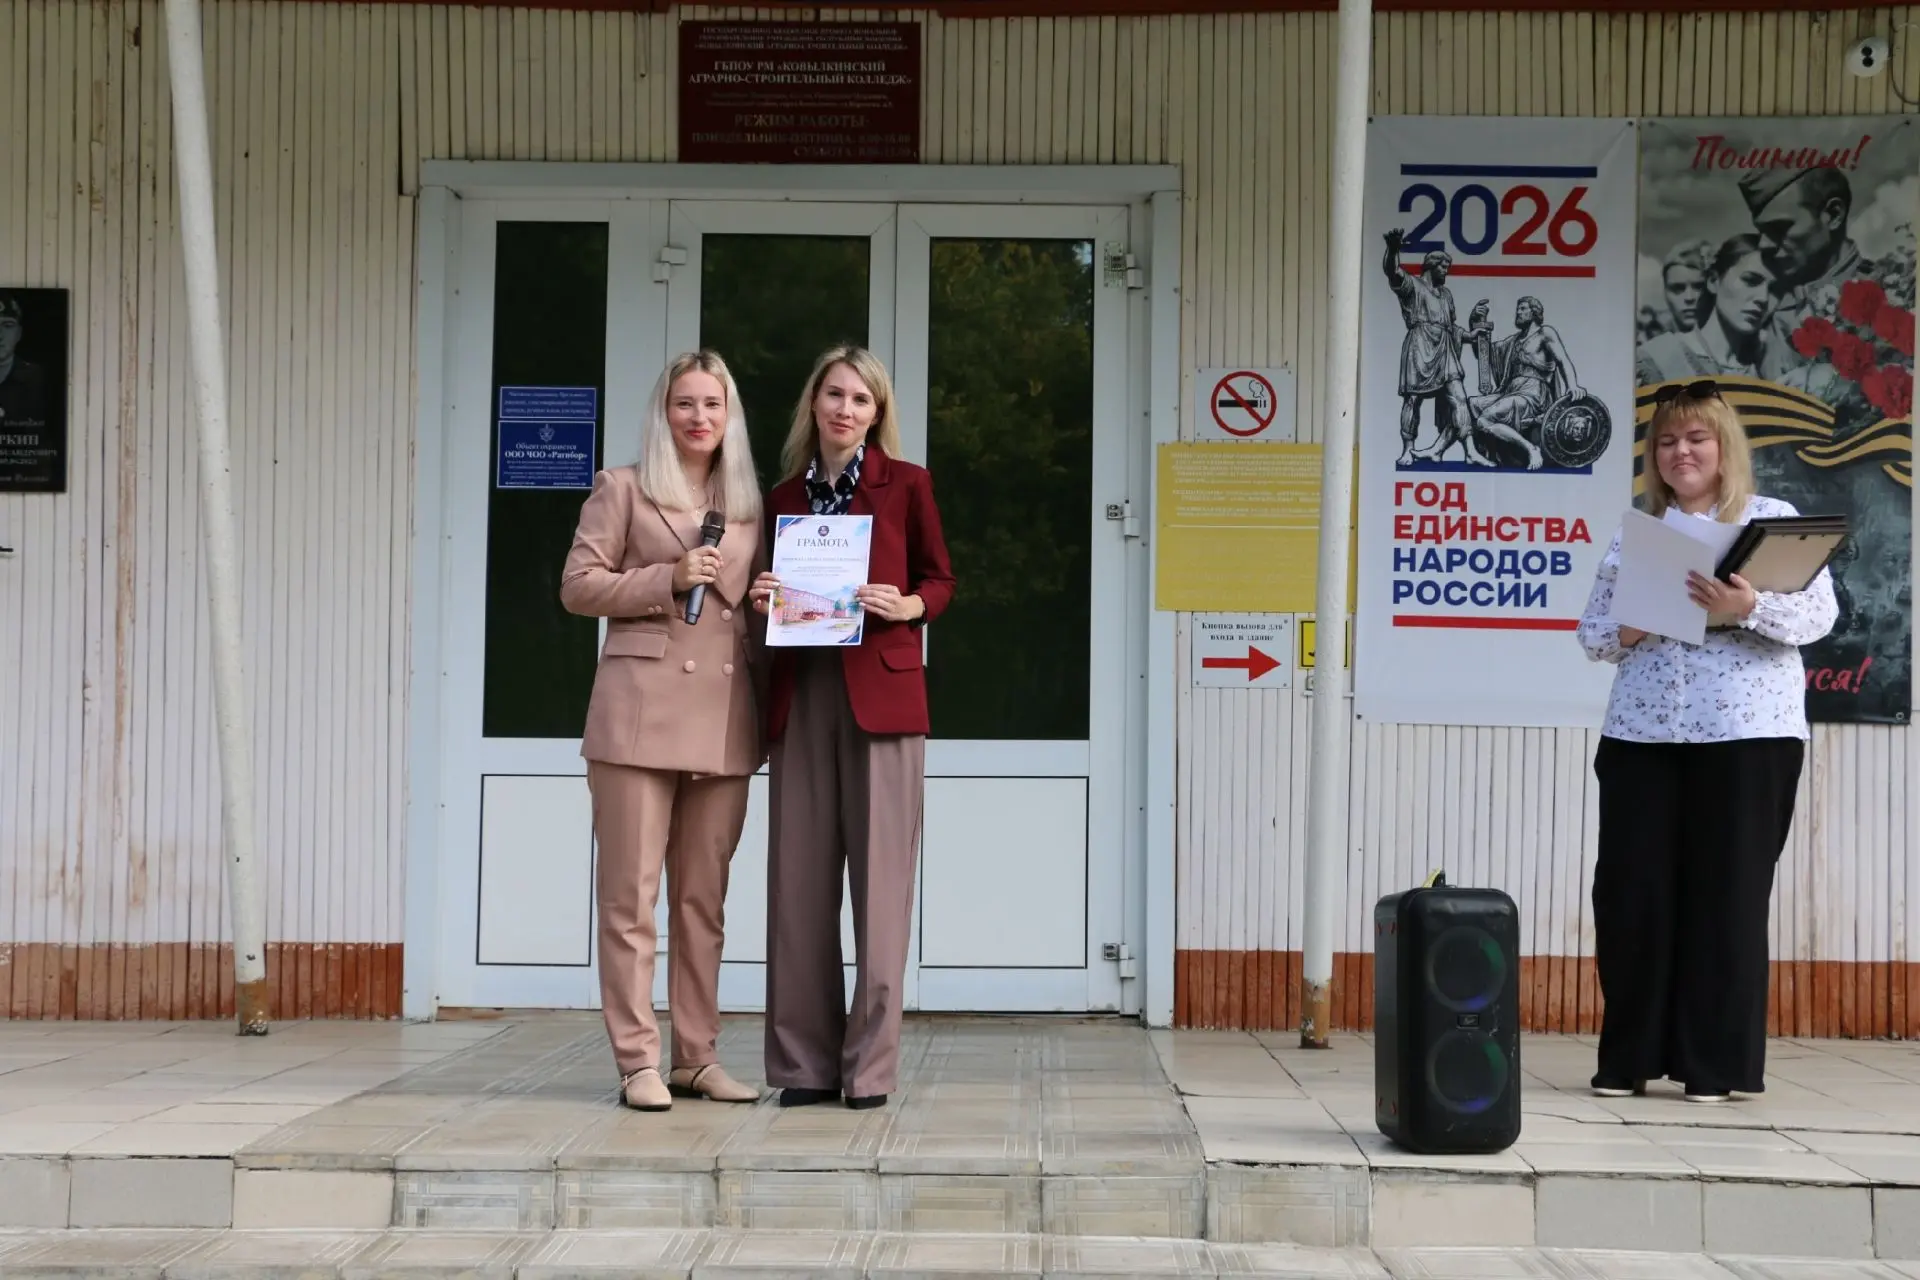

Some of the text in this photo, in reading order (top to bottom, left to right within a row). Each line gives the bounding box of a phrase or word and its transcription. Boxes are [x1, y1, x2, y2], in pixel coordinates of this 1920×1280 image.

[713, 60, 754, 71] ГБПОУ
[756, 61, 774, 71] РМ
[687, 72, 844, 84] АГРАРНО-СТРОИТЕЛЬНЫЙ
[734, 113, 795, 128] РЕЖИМ
[1690, 134, 1872, 172] Помним!
[1398, 183, 1598, 256] 2026
[0, 434, 39, 446] РКИН
[504, 450, 525, 458] ООО
[526, 450, 547, 459] ЧОО
[1393, 480, 1468, 514] ГОД
[1393, 514, 1592, 545] ЕДИНСТВА
[796, 538, 849, 548] ГРАМОТА
[1393, 547, 1573, 578] НАРОДОВ
[1392, 579, 1548, 608] РОССИИ
[1201, 622, 1234, 630] Кнопка
[1209, 634, 1235, 642] входа
[1804, 656, 1873, 695] ся!
